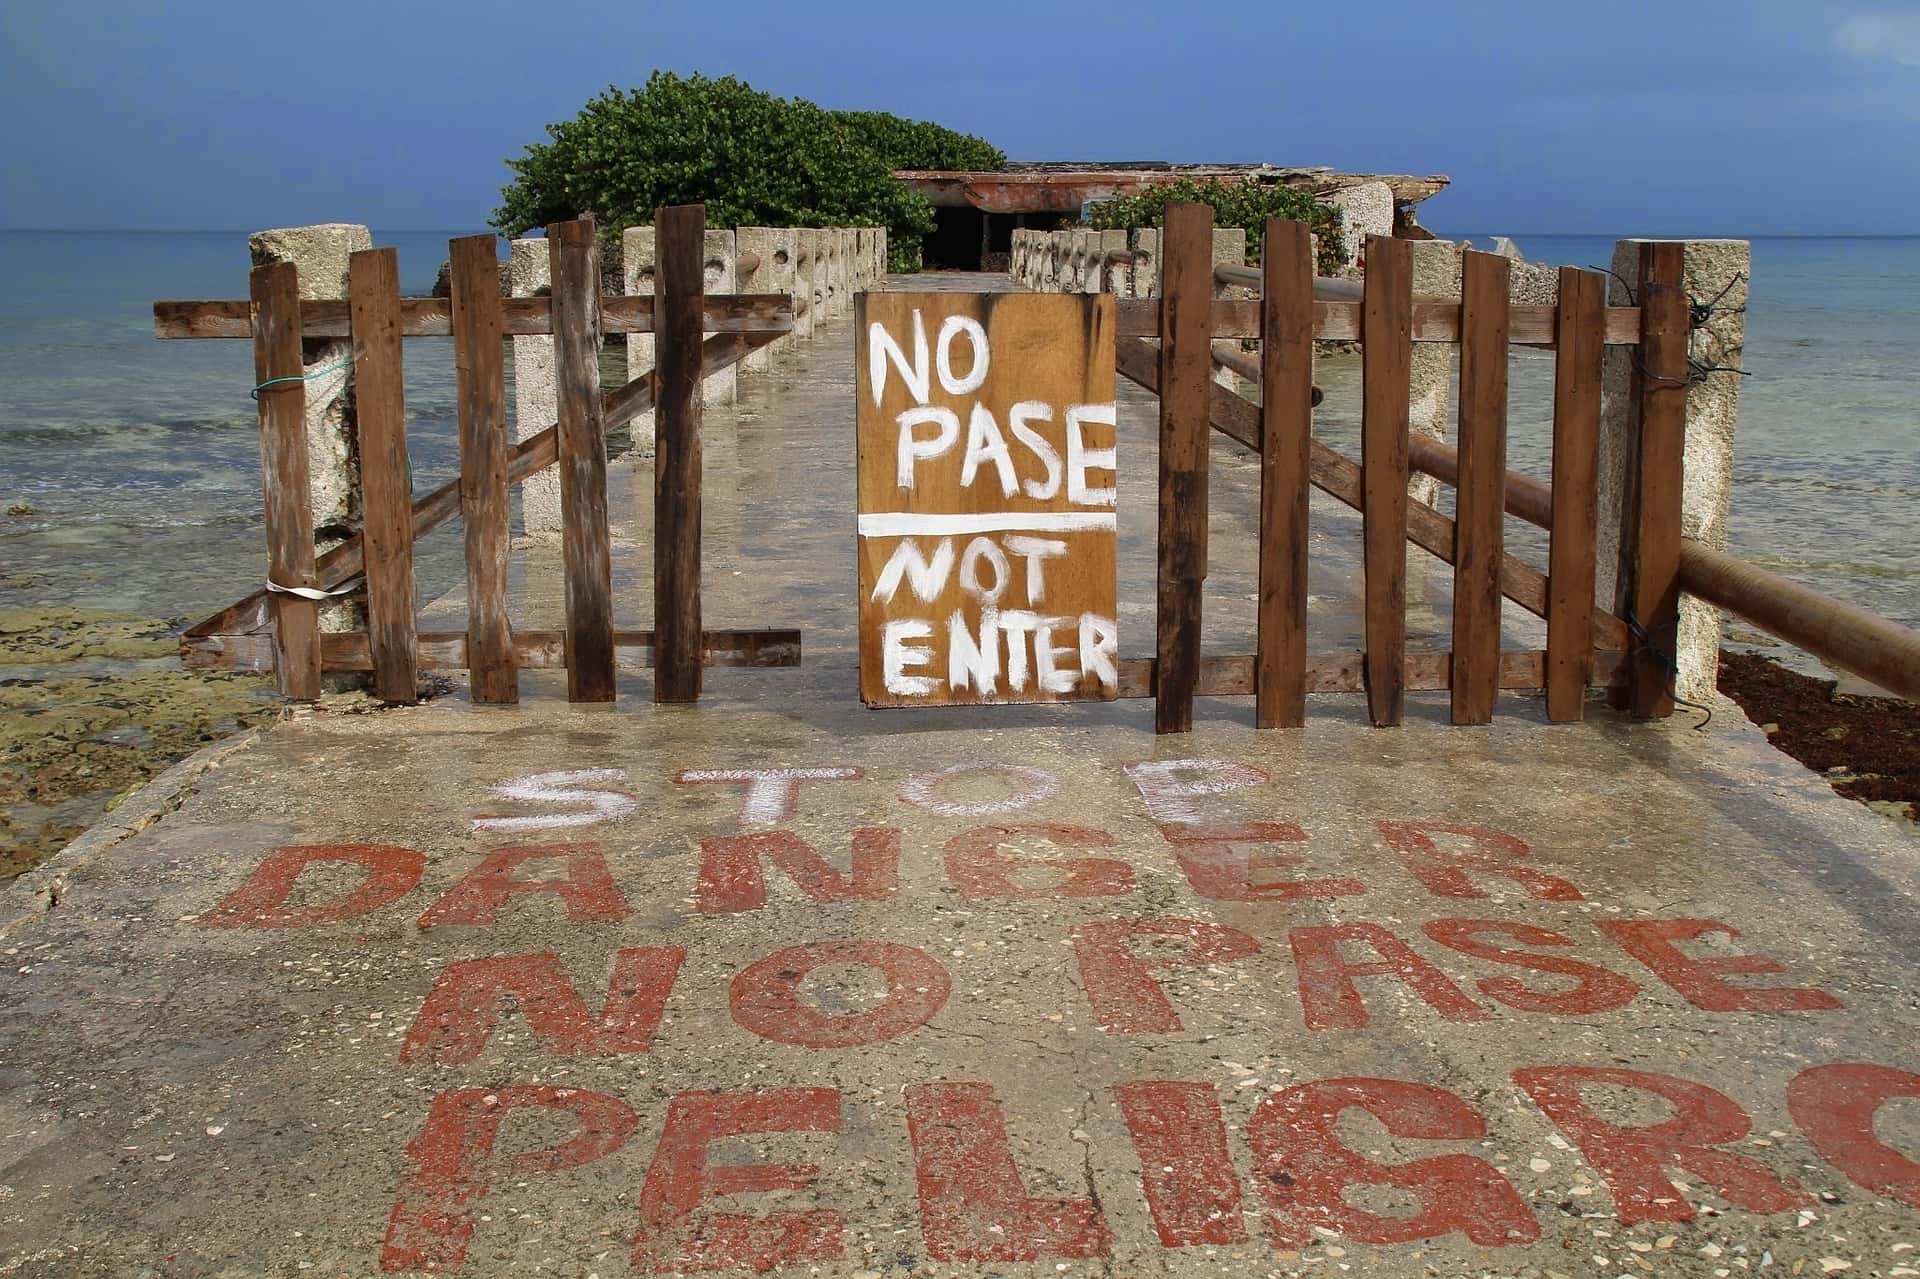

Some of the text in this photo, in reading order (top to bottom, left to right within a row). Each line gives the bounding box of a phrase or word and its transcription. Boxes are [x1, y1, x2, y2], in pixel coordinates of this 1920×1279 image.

[868, 308, 991, 408] NO
[895, 400, 1117, 506] PASE
[871, 534, 1071, 606] NOT
[880, 604, 1117, 696] ENTER
[472, 759, 1270, 832] STOP
[200, 820, 1586, 930] DANGER
[400, 917, 1845, 1066] NO PASE
